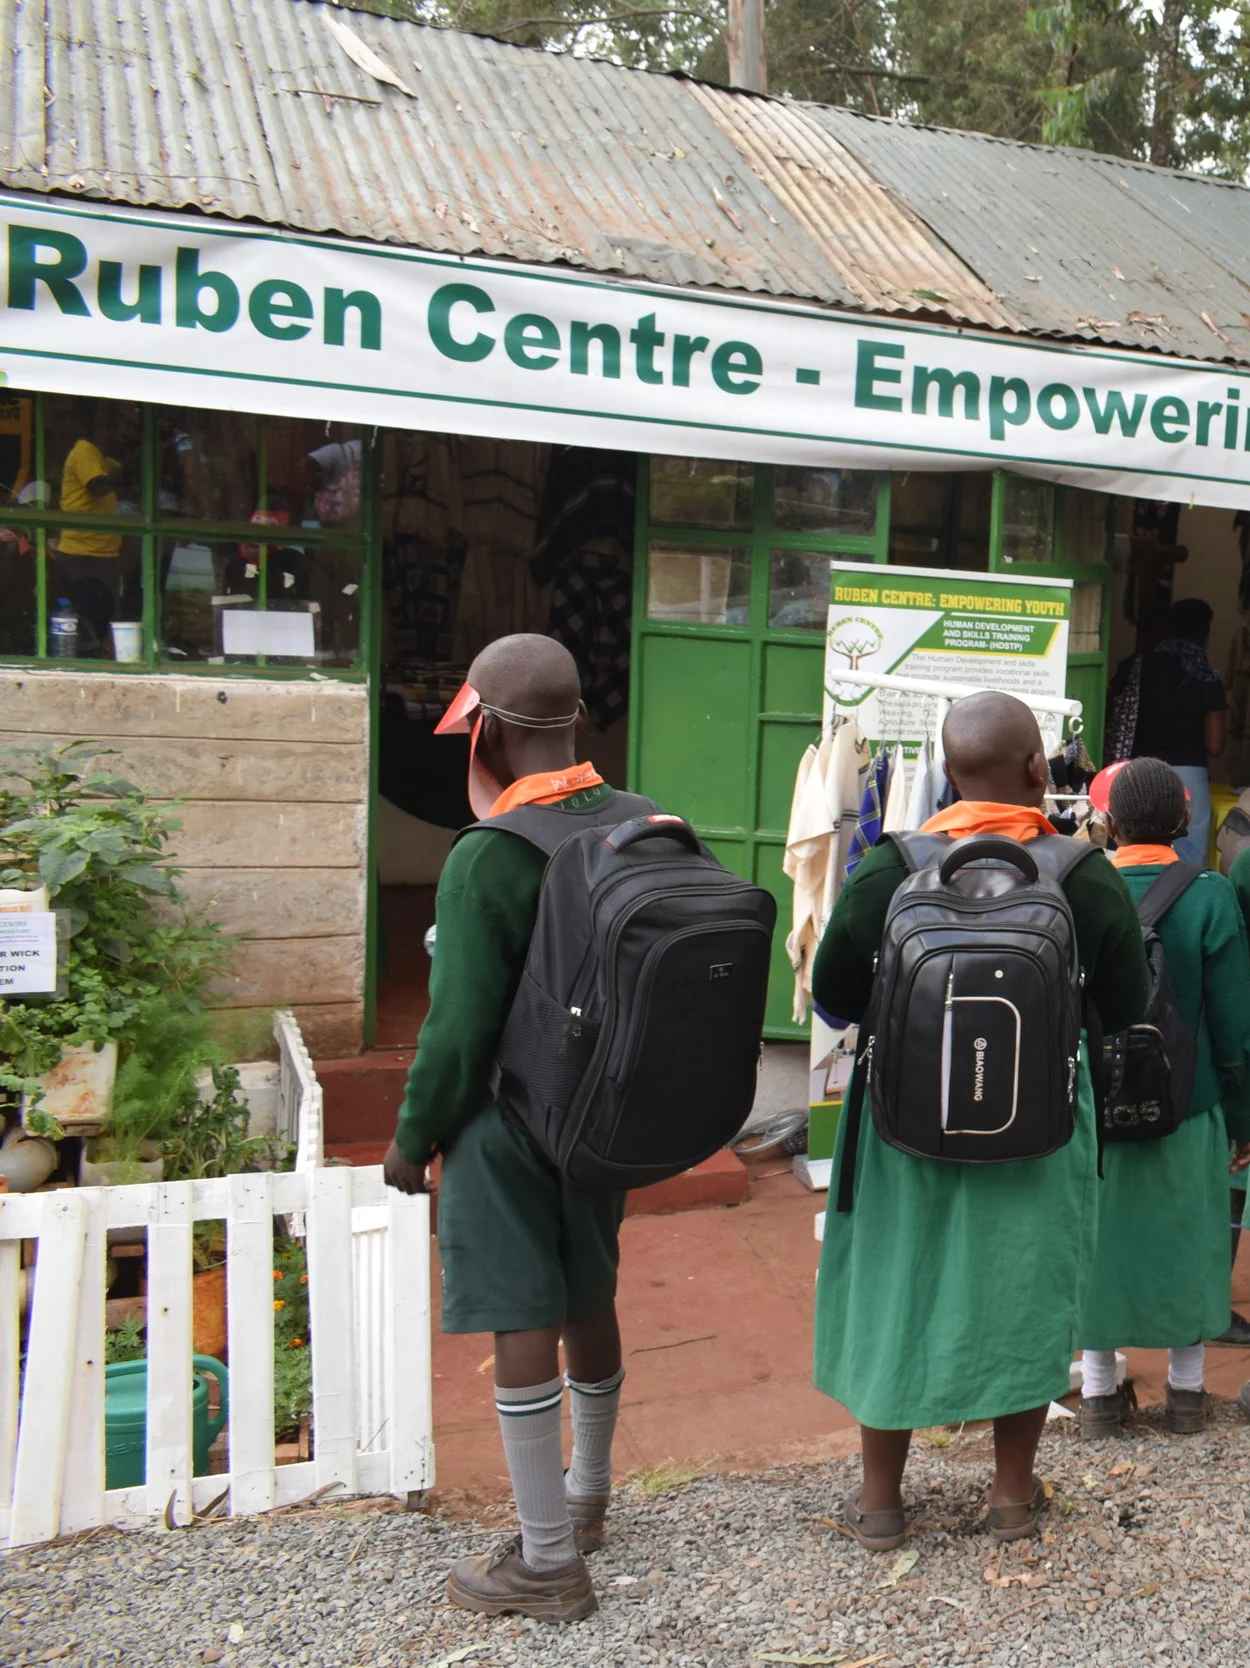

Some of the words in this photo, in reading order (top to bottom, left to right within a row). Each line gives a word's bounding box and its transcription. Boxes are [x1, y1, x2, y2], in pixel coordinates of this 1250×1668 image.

[7, 224, 383, 350] Ruben
[428, 283, 764, 395] Centre
[835, 586, 879, 603] RUBEN
[881, 589, 937, 607] CENTRE:
[939, 593, 1022, 613] EMPOWERING
[1024, 599, 1065, 616] YOUTH
[943, 620, 974, 630] HUMAN
[975, 621, 1035, 633] DEVELOPMENT
[943, 629, 961, 638] AND
[962, 630, 990, 640] SKILLS
[992, 632, 1031, 642] TRAINING
[11, 949, 41, 958] WICK
[973, 1050, 986, 1103] BIAOWANG
